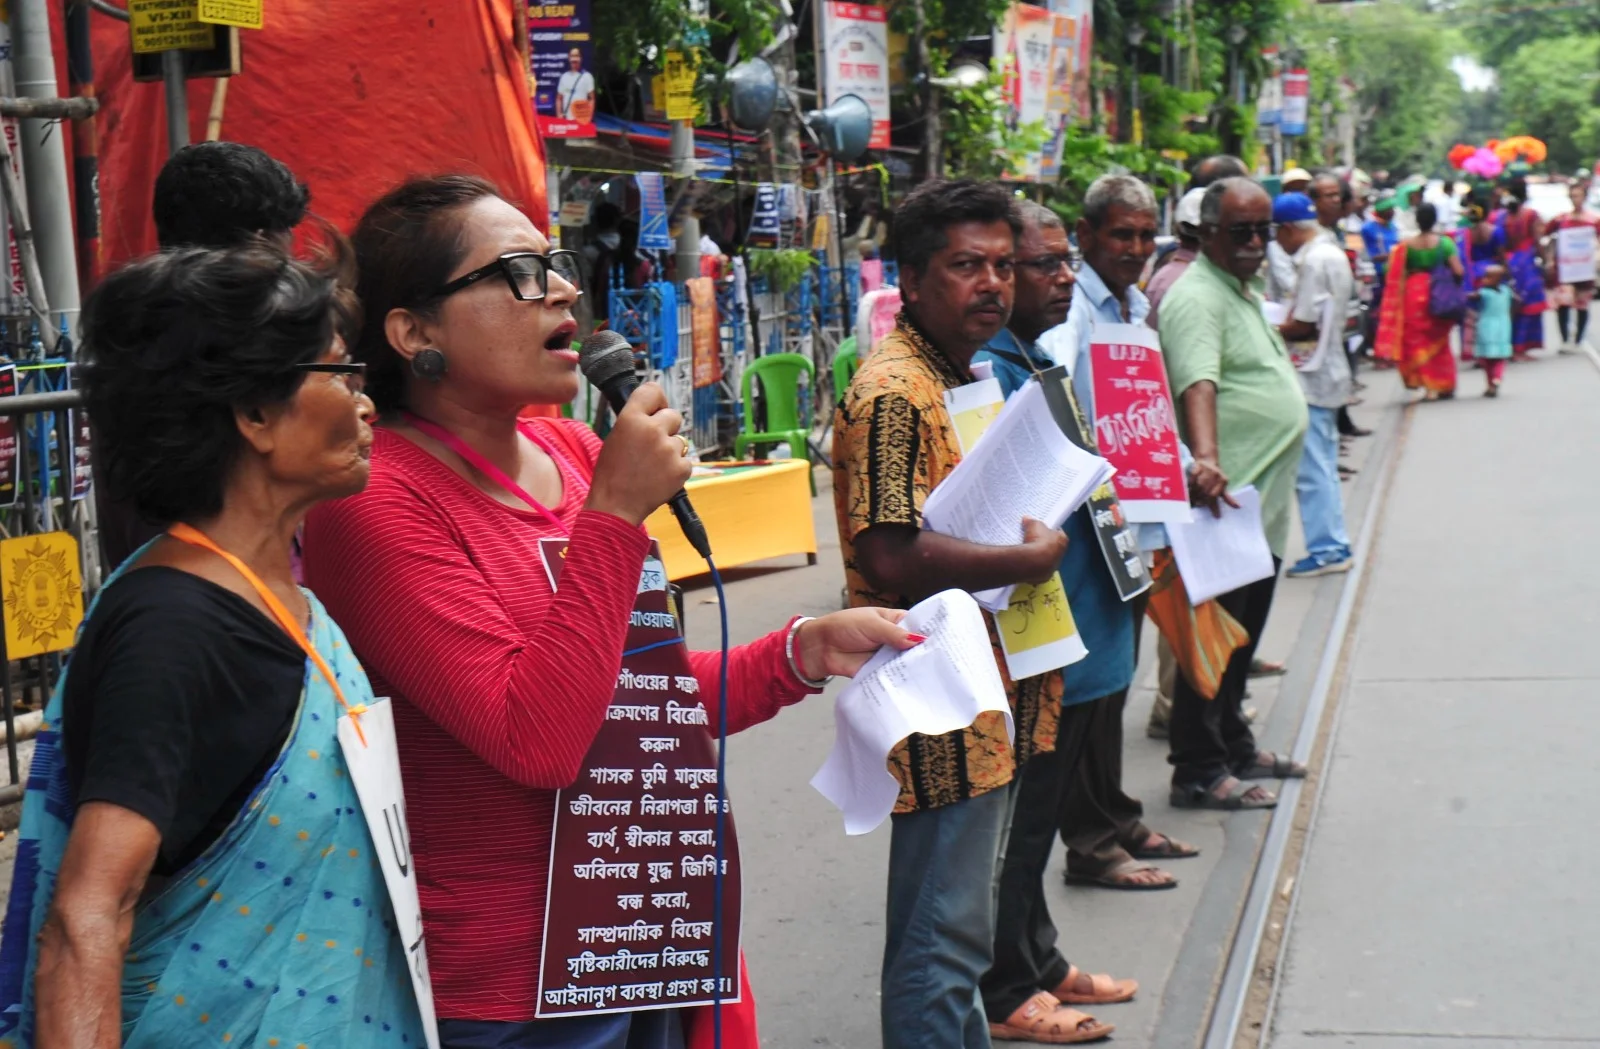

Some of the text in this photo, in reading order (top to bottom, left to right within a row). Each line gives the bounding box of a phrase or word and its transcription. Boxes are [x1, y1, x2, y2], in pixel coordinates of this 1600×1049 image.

[606, 704, 660, 721] ক্রমণের
[589, 762, 718, 790] শাসক তুমি মানুষের
[569, 794, 632, 816] জীবনের
[639, 794, 698, 816] নিরাপত্তা
[624, 825, 673, 848] স্বীকার
[678, 828, 717, 848] করো,
[573, 857, 640, 880] অবিলম্বে
[647, 861, 673, 883] যুদ্ধ
[617, 891, 690, 911] বন্ধ করো,
[577, 917, 713, 944] সাম্প্রদায়িক বিদ্বেষ
[567, 946, 710, 979] সৃষ্টিকারীদের বিরুদ্ধে
[544, 983, 617, 1008] আইনানুগ
[620, 981, 664, 1001] ব্যবস্থা
[667, 978, 699, 996] গ্রহণ
